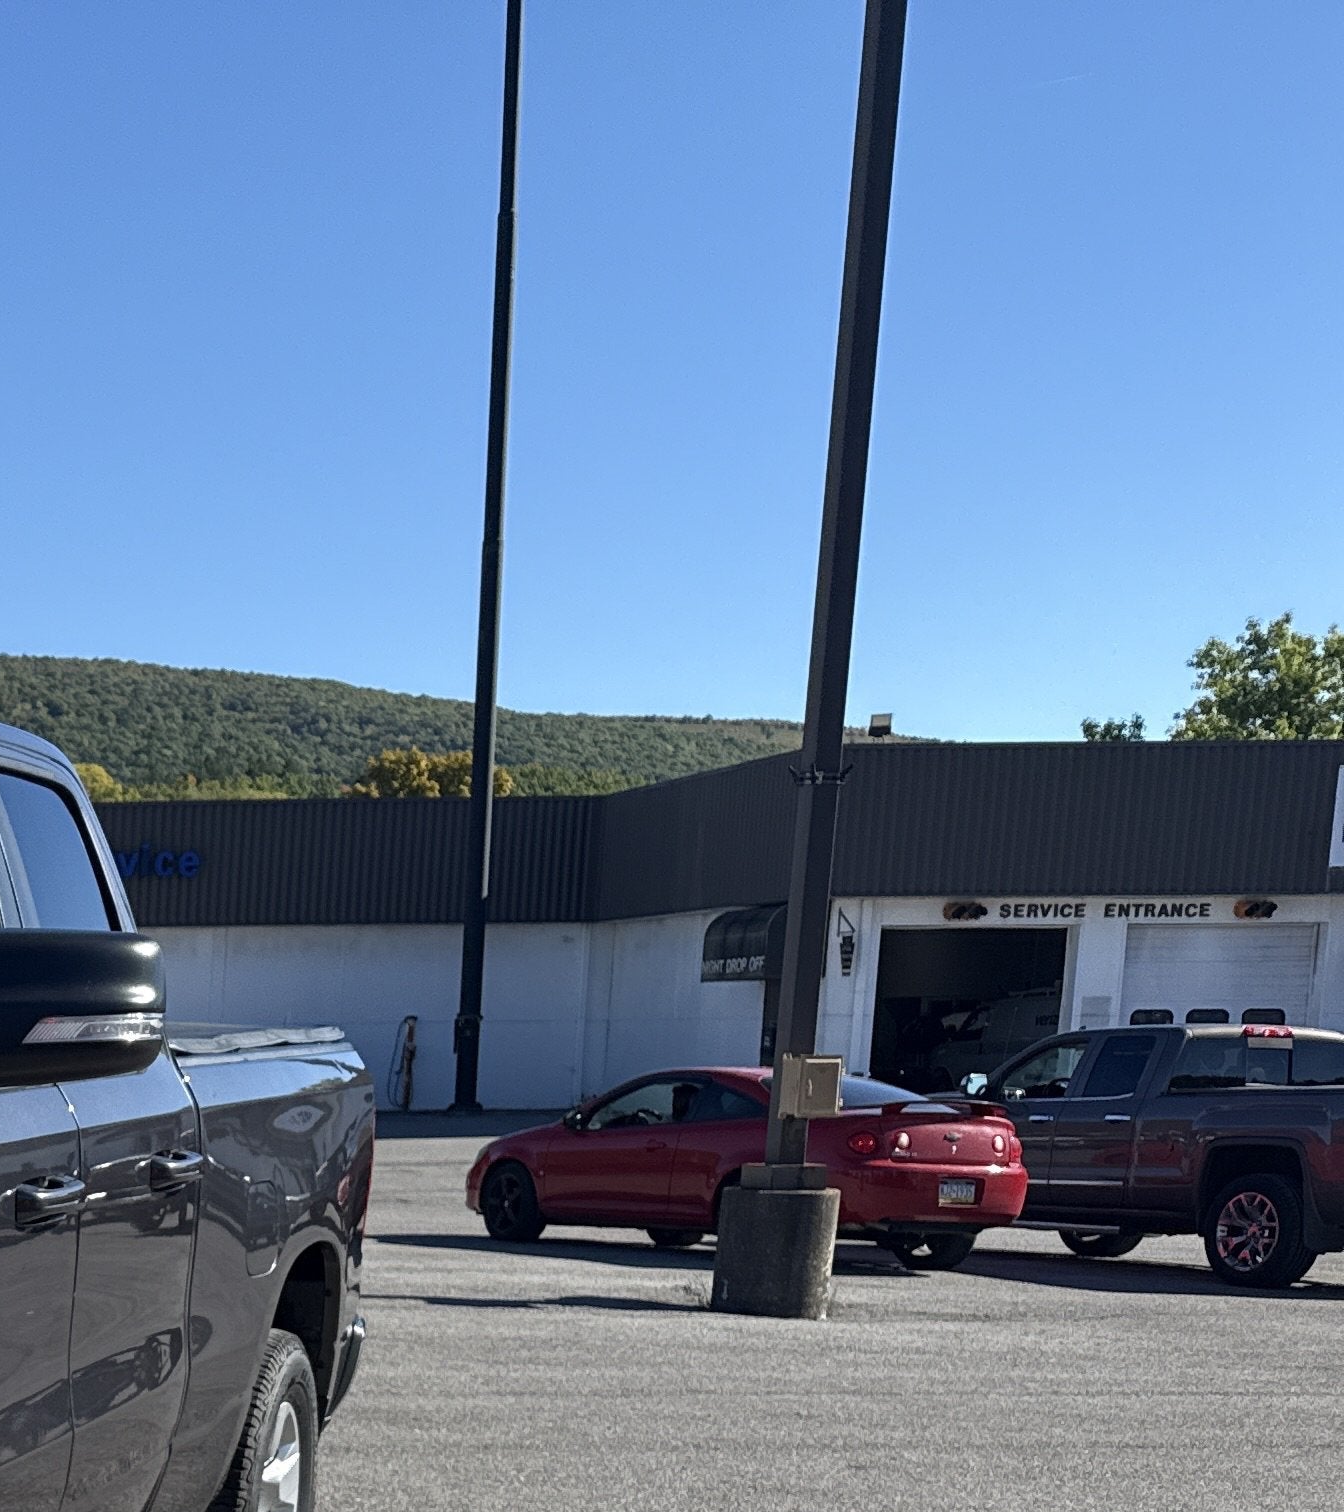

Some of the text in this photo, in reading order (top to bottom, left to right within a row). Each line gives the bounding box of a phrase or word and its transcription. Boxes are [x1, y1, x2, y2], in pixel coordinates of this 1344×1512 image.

[118, 842, 200, 878] vice
[999, 902, 1212, 919] SERVICE ENTRANCE
[725, 957, 748, 974] DROP
[749, 955, 766, 973] OFF
